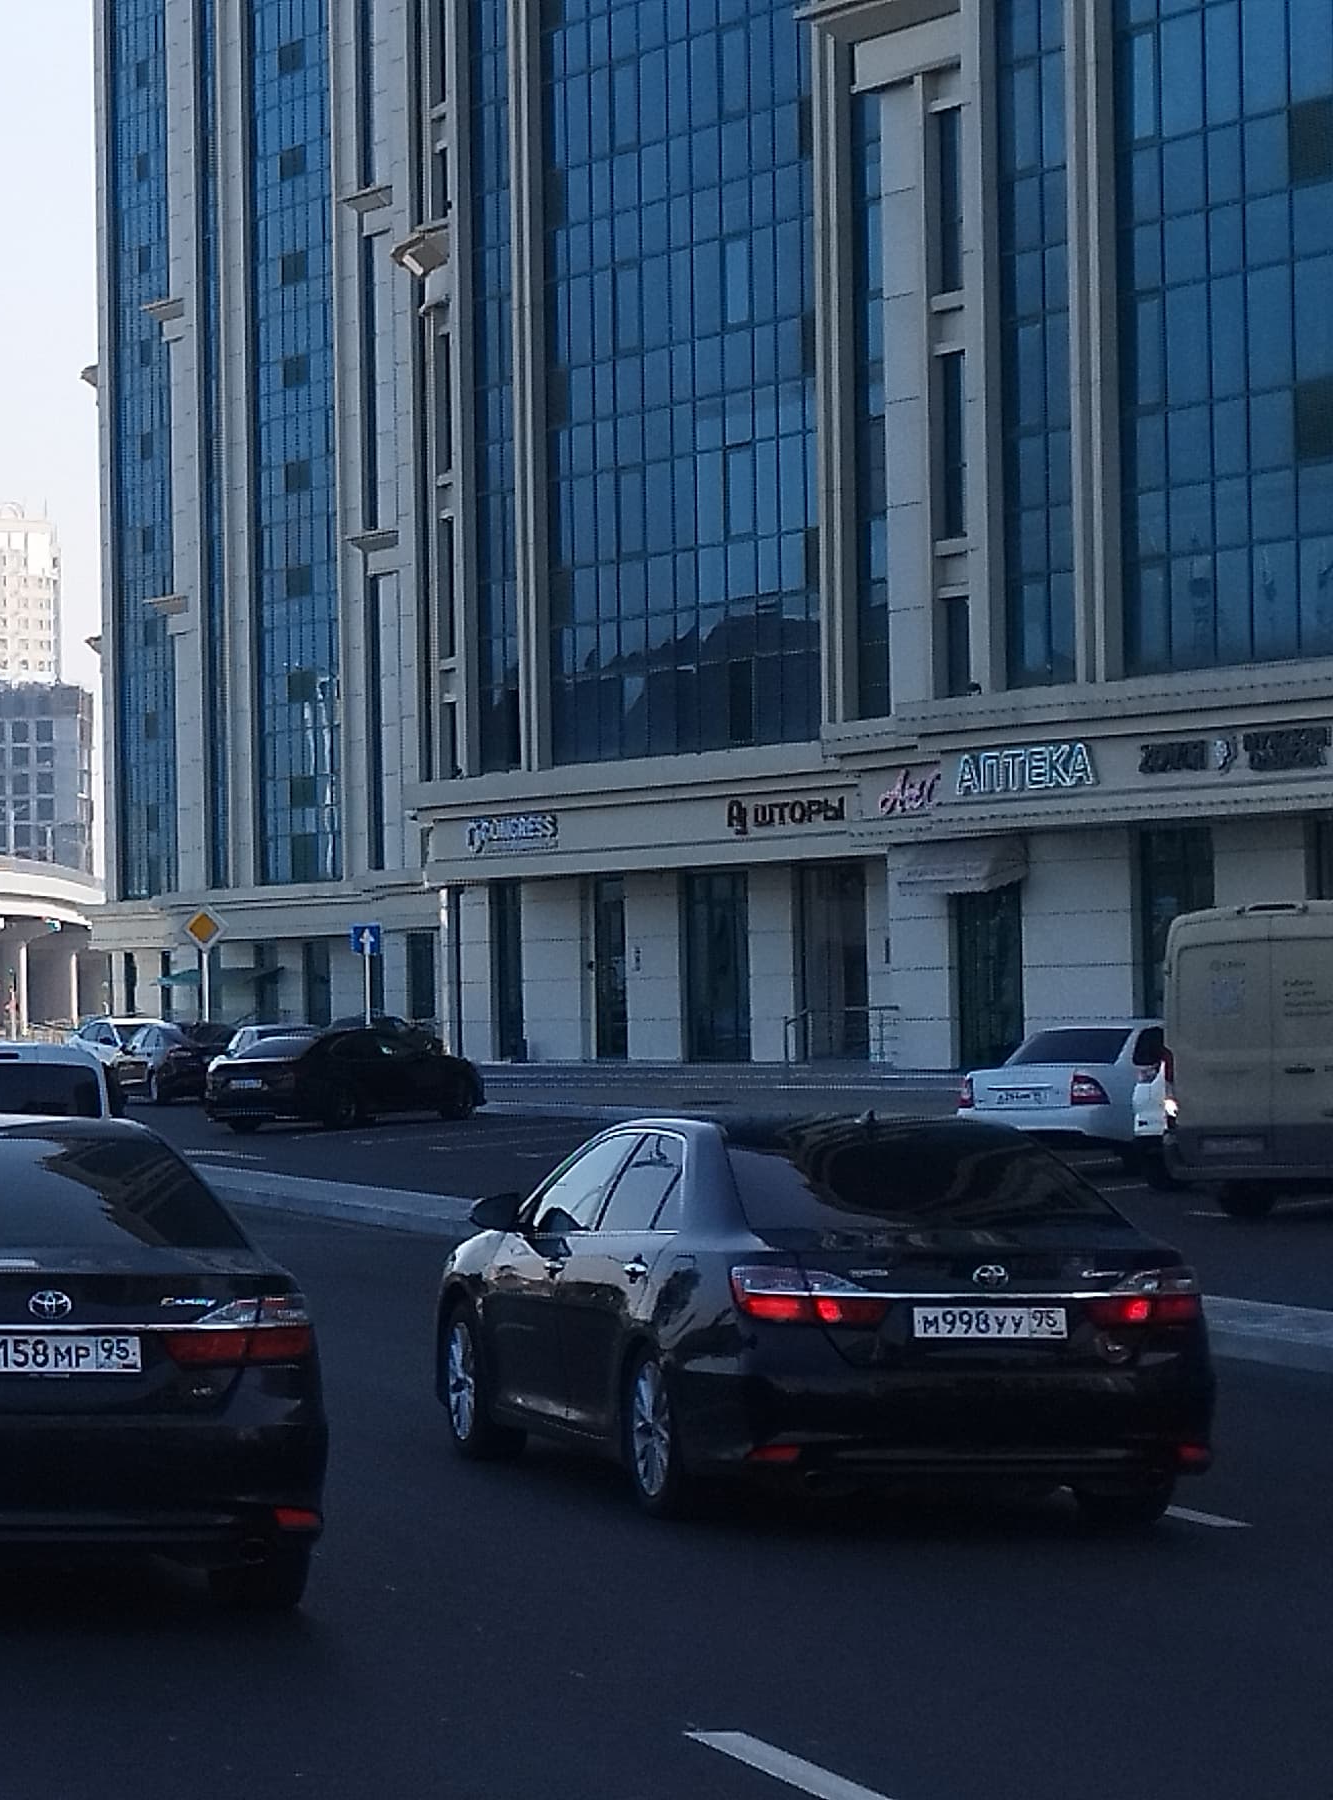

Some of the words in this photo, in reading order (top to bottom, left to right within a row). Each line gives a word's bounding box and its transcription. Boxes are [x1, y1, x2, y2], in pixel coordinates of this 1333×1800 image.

[955, 741, 1095, 796] АПТЕКА
[753, 795, 845, 828] ШТОРЫ
[100, 1338, 131, 1360] 95
